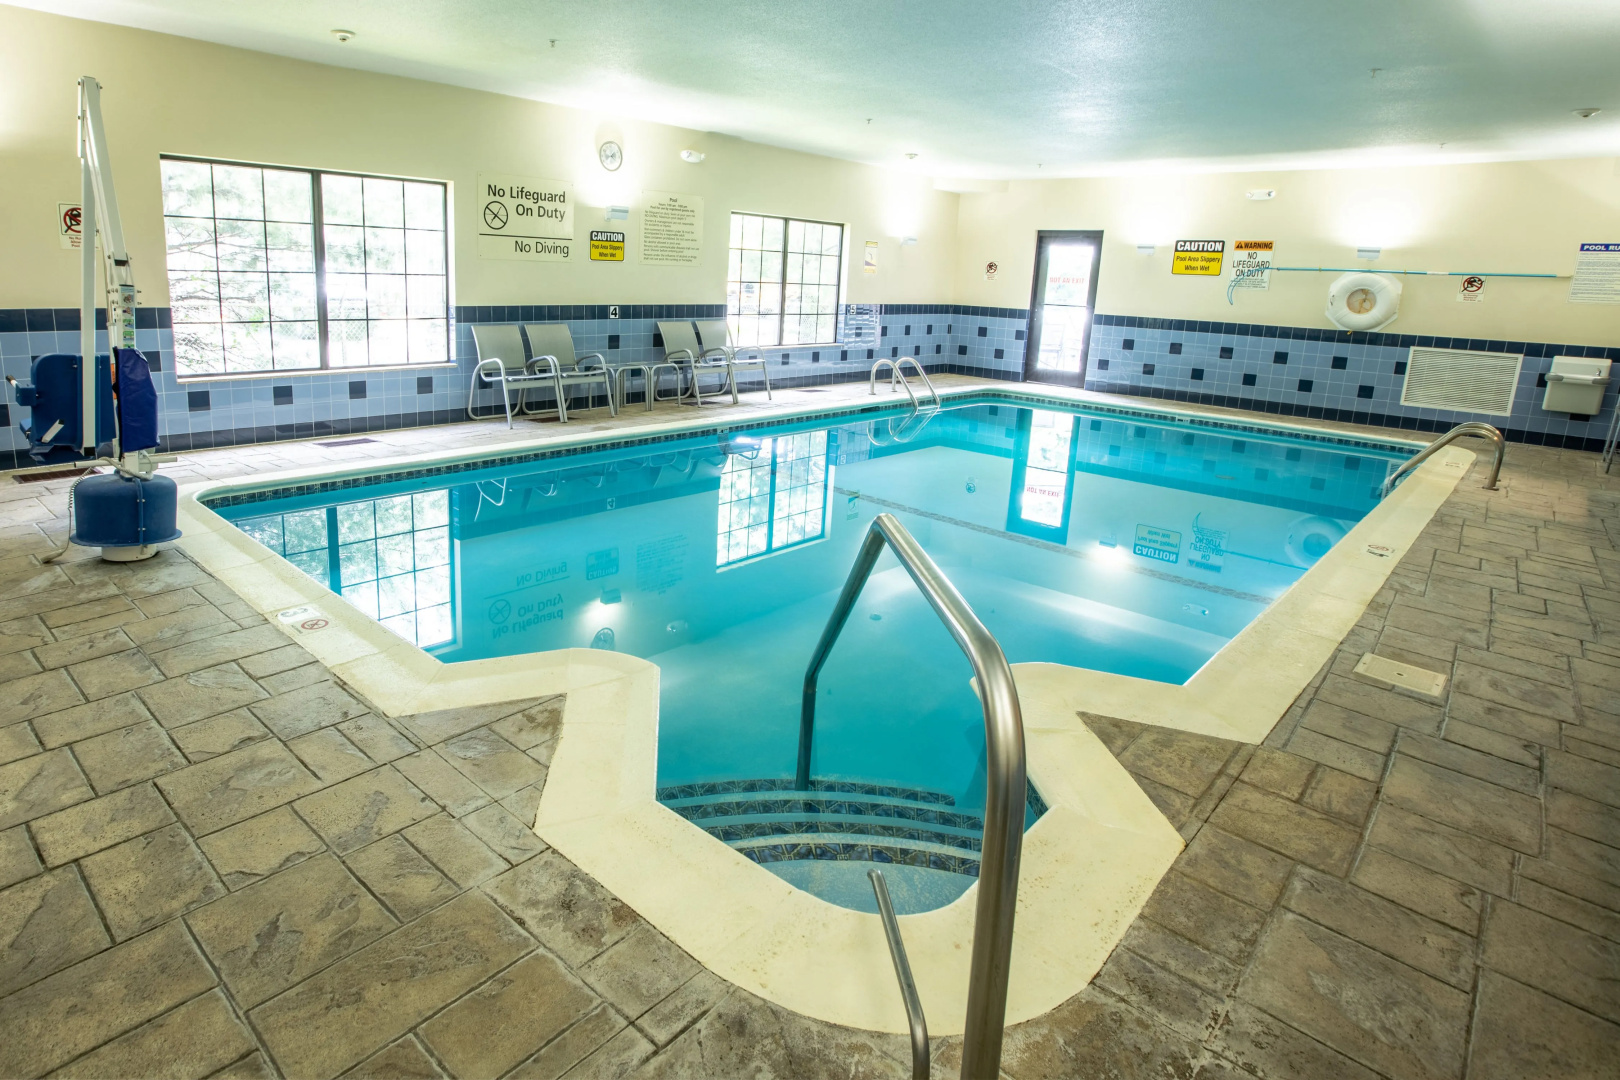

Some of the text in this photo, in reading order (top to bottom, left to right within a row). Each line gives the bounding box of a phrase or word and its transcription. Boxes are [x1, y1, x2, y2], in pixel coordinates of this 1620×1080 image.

[487, 184, 566, 204] No Lifeguard
[515, 203, 566, 223] On Duty
[592, 231, 623, 242] CAUTION
[514, 240, 569, 258] No Diving
[1177, 241, 1223, 252] CAUTION
[1200, 255, 1221, 263] Slippery
[1247, 251, 1258, 260] NO
[1199, 264, 1210, 272] Wet
[1232, 260, 1270, 269] LIFEGUARD
[1235, 268, 1266, 278] ON DUTY
[611, 307, 618, 317] 4
